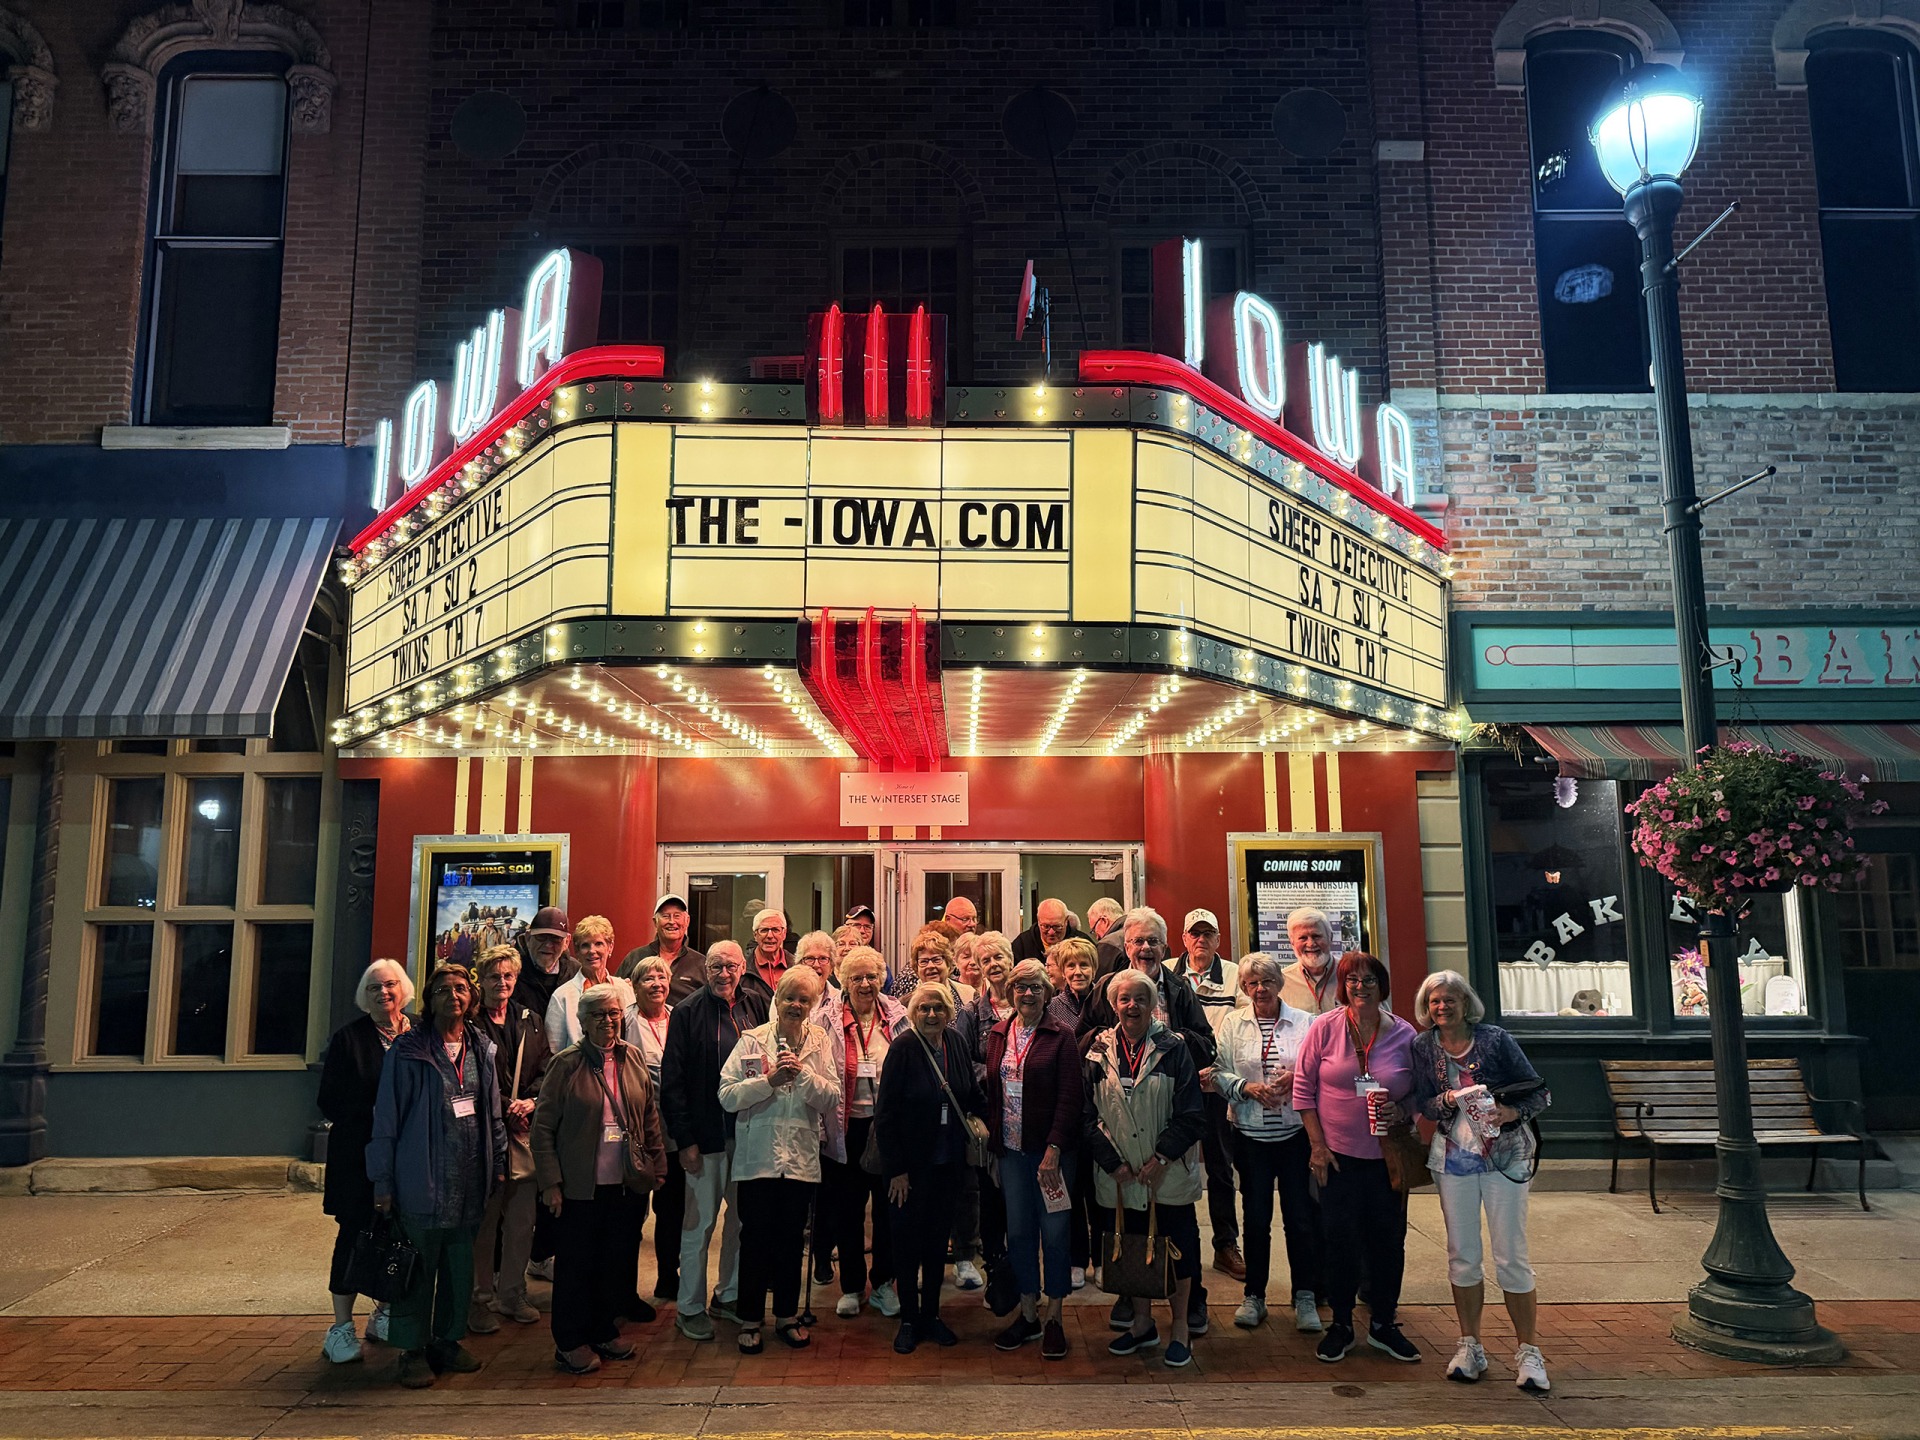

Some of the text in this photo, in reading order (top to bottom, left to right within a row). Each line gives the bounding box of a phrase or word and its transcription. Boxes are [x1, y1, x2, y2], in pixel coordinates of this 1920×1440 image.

[371, 246, 572, 513] IOWA
[1182, 236, 1417, 508] IOWA
[387, 488, 502, 601] SHEEP DETECTIVE
[665, 498, 759, 544] THE
[1269, 498, 1408, 601] SHEEP DETECTIVE
[402, 557, 477, 636] SA 7 SU 2
[1300, 566, 1388, 638] SA 7 SU 2
[392, 605, 484, 686] TWINS TH 7
[1286, 611, 1388, 684] TWINS TH 7
[848, 794, 961, 804] THE WINTERSET STAGE
[508, 864, 534, 874] SOO
[1264, 860, 1341, 871] COMING SOON
